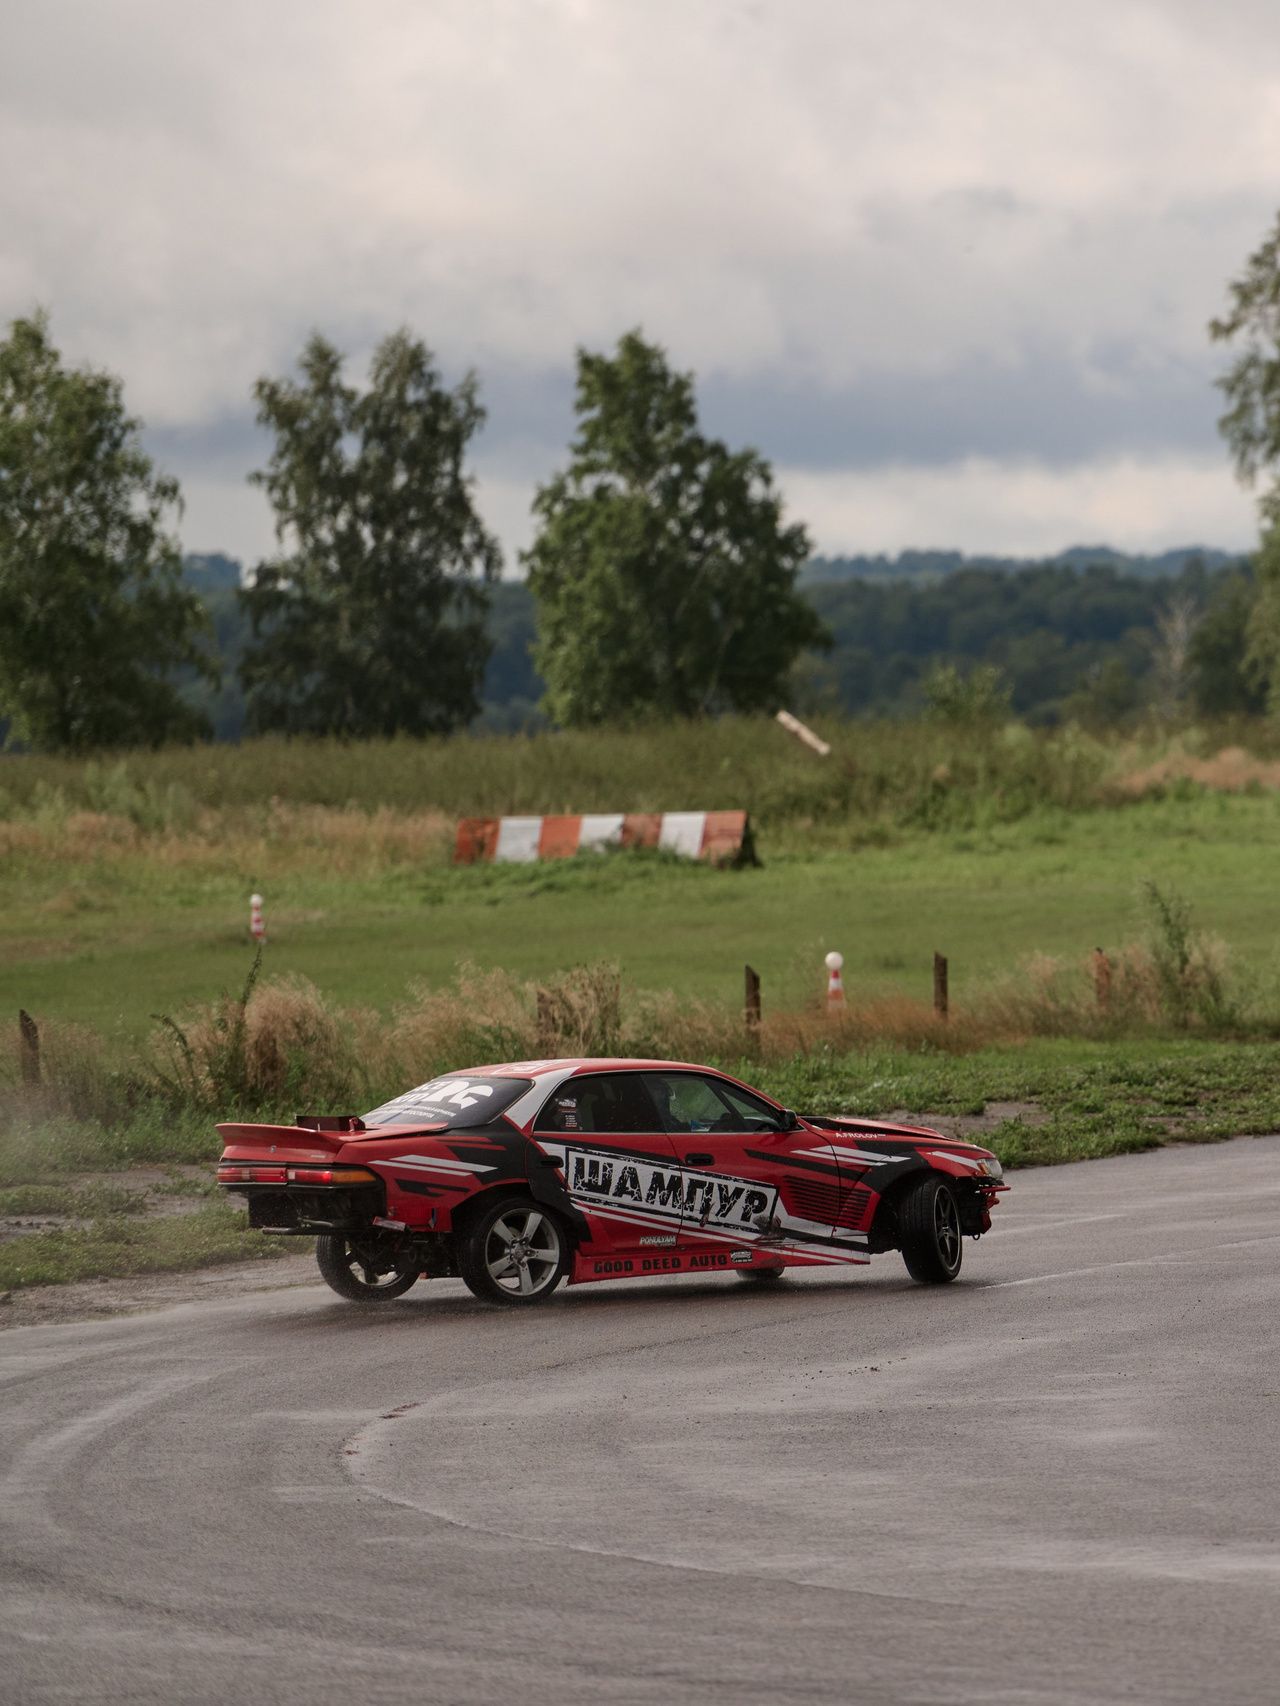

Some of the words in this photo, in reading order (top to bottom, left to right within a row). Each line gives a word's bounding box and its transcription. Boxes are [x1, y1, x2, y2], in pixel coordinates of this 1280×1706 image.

[573, 1157, 768, 1222] ШАМПУР
[594, 1261, 634, 1273] GOOD
[642, 1257, 681, 1270] DEED
[689, 1254, 727, 1267] AUTO
